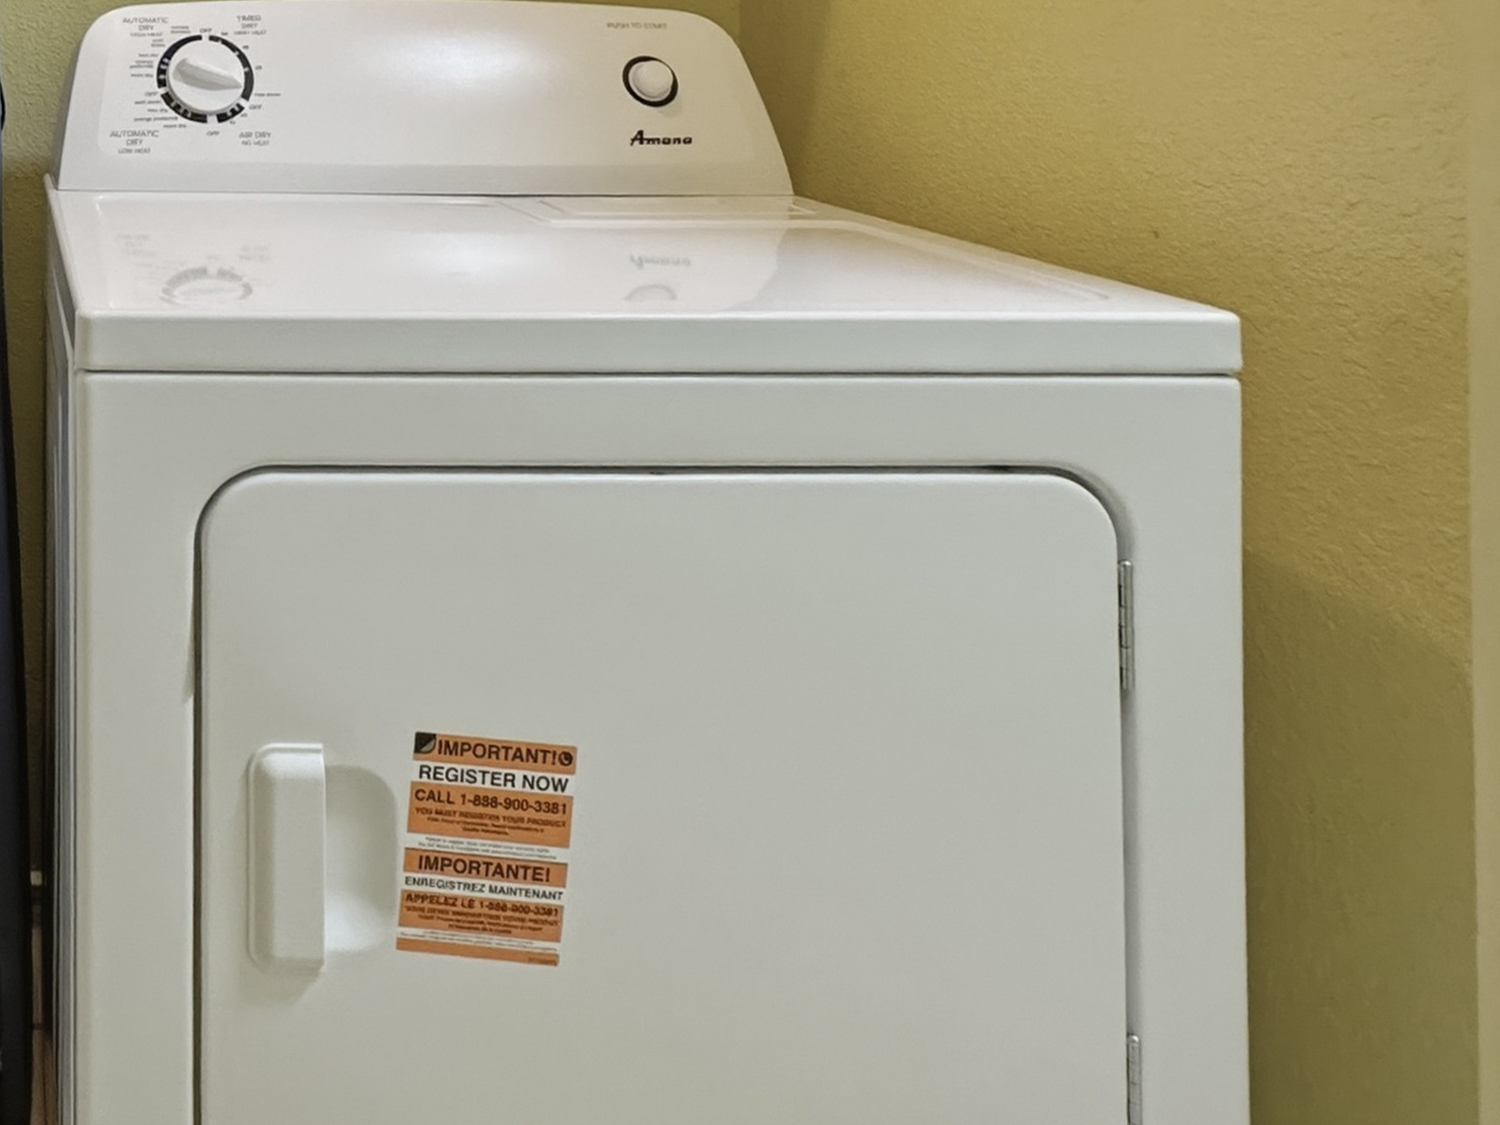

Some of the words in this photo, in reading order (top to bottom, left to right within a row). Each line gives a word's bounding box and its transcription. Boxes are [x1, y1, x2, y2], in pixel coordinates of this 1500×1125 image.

[629, 129, 693, 147] Amana
[437, 739, 558, 766] IMPORTANT!
[418, 764, 517, 789] REGISTER
[521, 774, 570, 793] NOW
[414, 788, 456, 805] CALL
[460, 793, 568, 816] 1-888-900-3381
[417, 854, 551, 883] IMPORTANTE!
[404, 876, 486, 894] ENREGISTREZ
[488, 884, 564, 901] MAINTENANT
[405, 893, 458, 908] APPELEZ
[461, 897, 476, 909] LE
